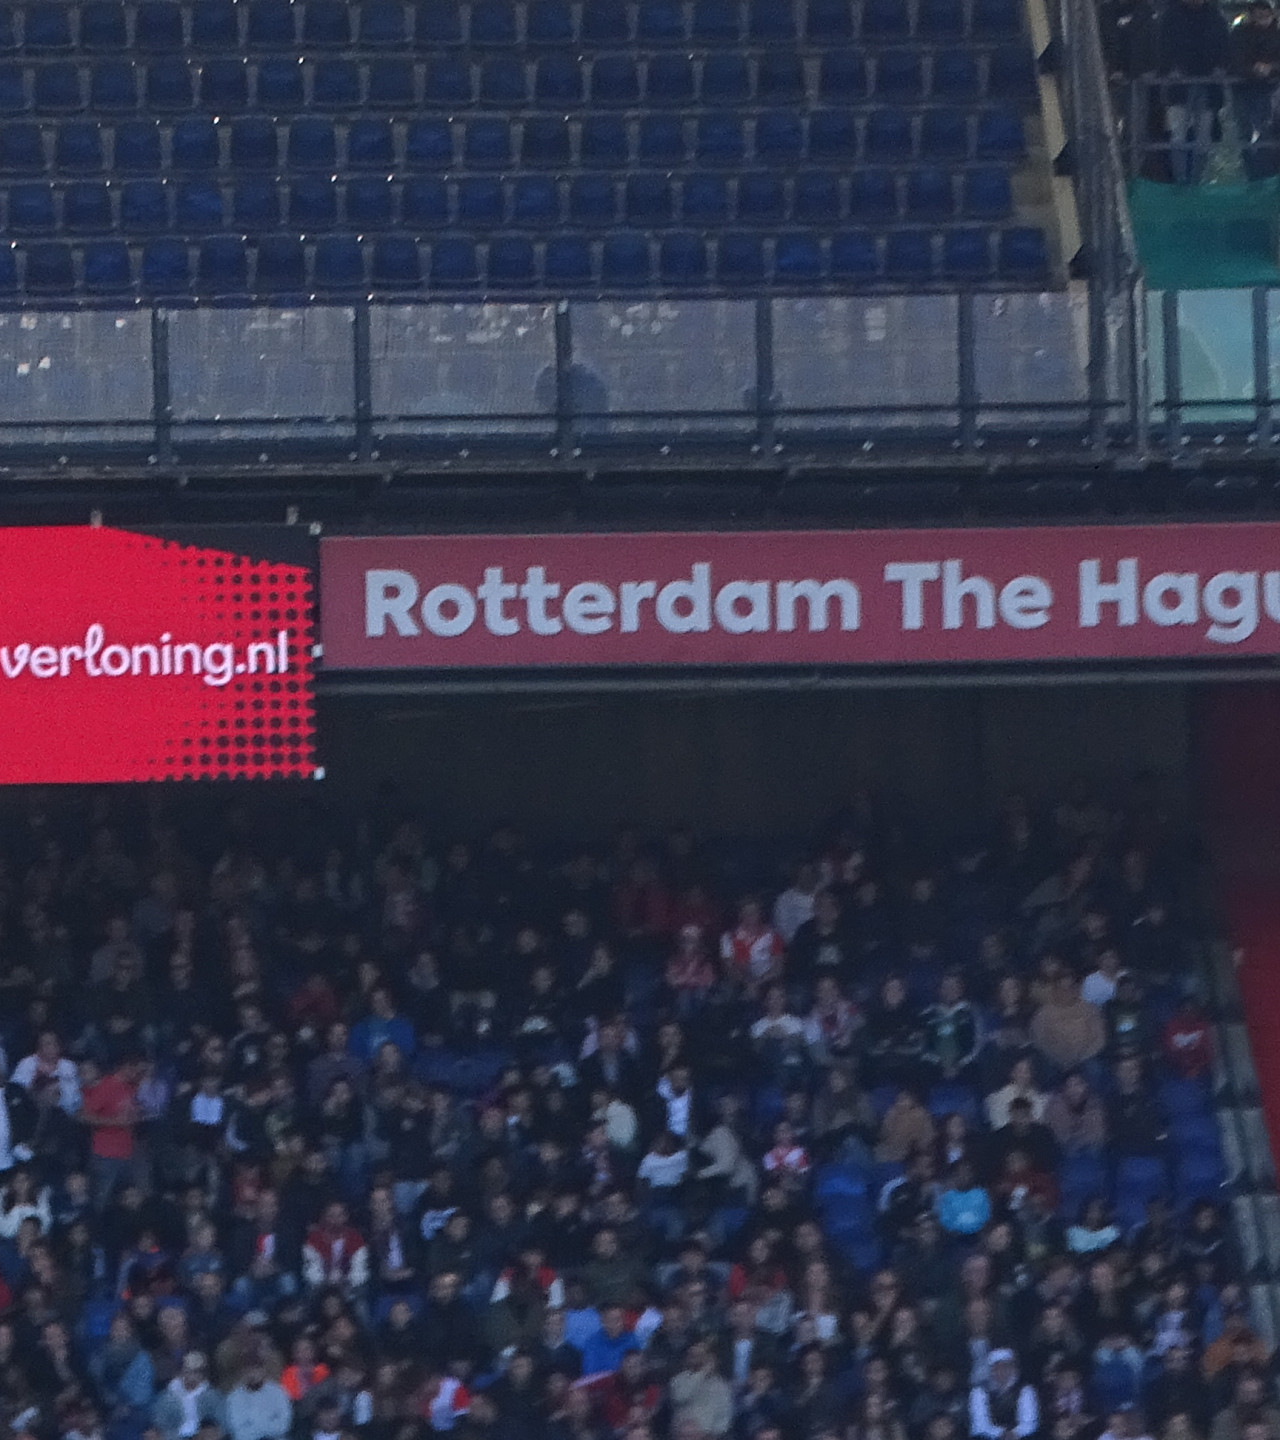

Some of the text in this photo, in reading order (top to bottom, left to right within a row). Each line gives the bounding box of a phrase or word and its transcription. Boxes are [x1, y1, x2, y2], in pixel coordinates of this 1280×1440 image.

[364, 562, 860, 638] Rotterdam
[884, 559, 1054, 631] The
[0, 623, 289, 686] verloning.nl
